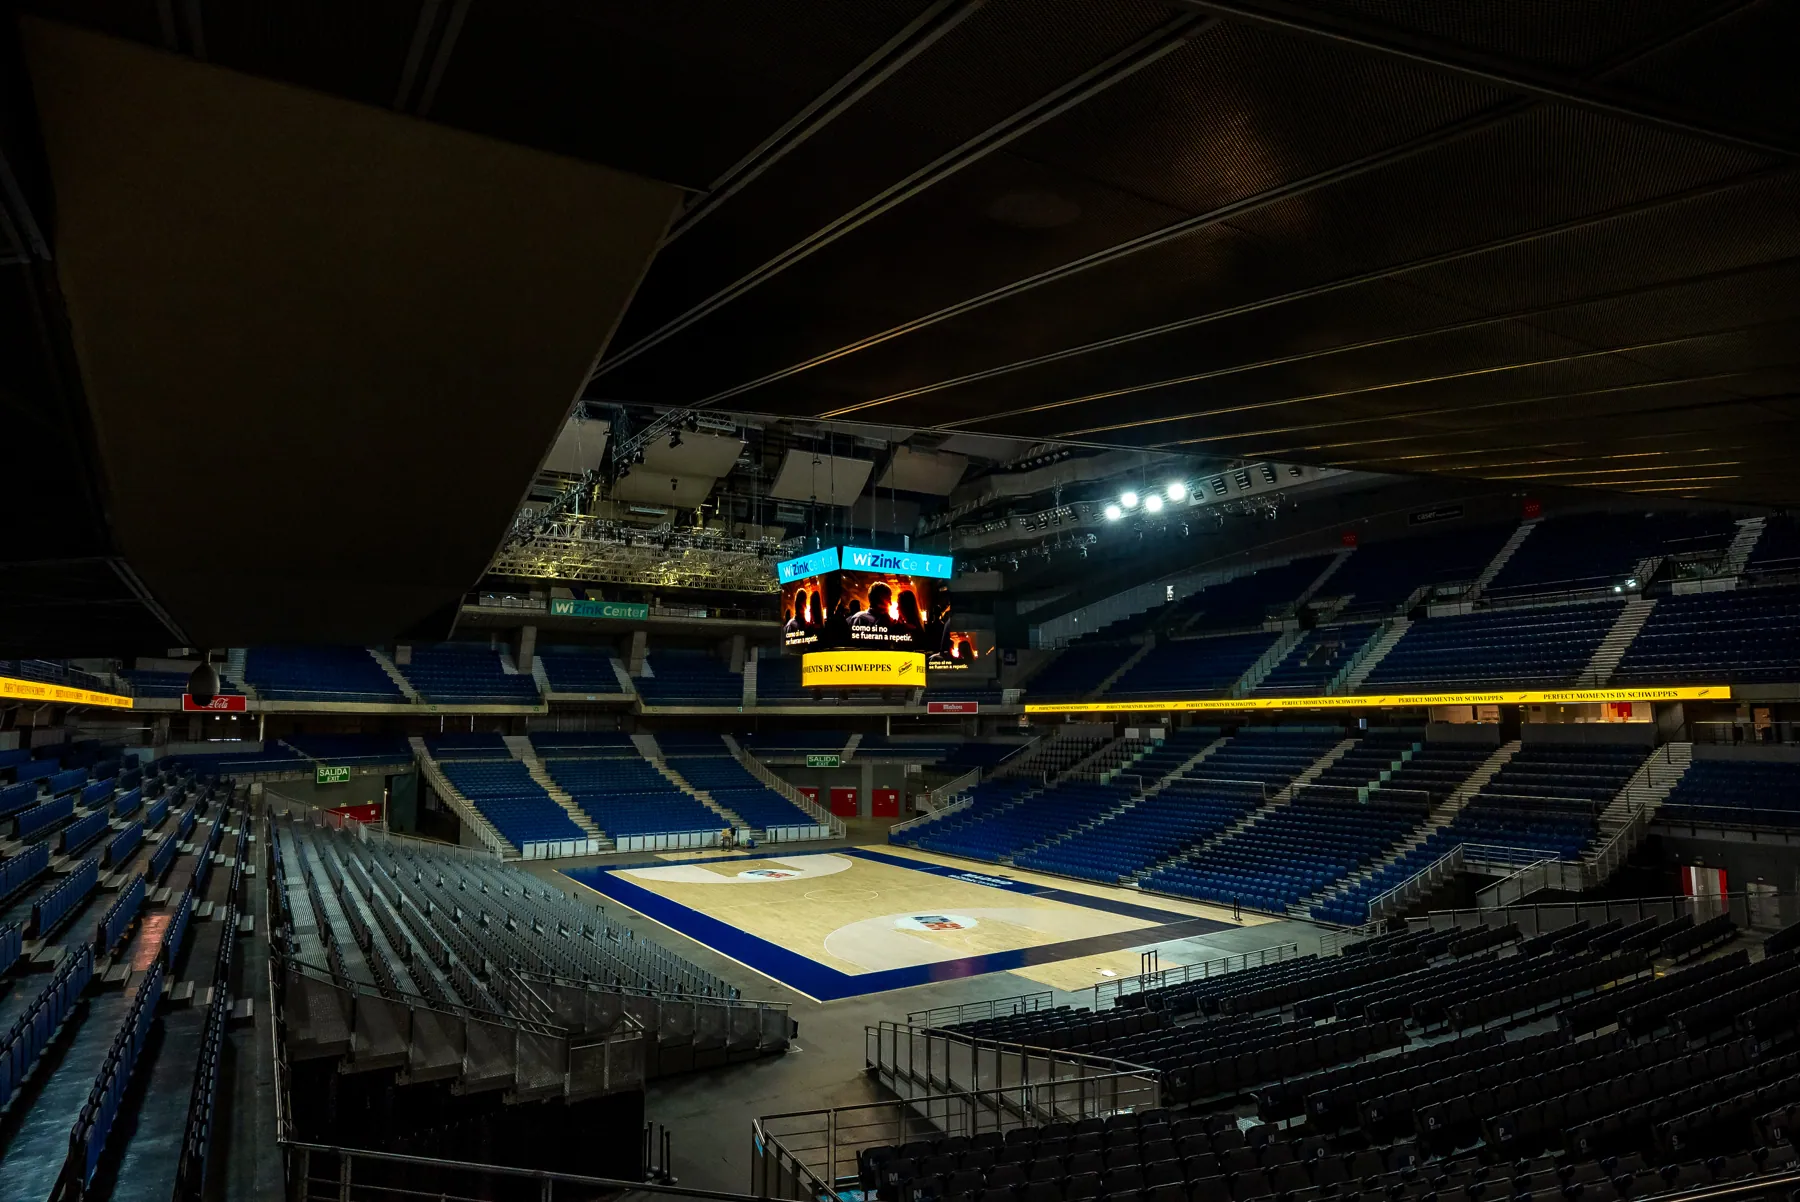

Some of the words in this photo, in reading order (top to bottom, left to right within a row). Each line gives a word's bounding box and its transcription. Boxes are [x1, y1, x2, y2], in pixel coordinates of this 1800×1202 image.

[871, 624, 878, 632] si
[860, 631, 883, 640] fueran
[889, 633, 913, 643] repetir.
[835, 664, 892, 672] SCHWEPPES
[1628, 690, 1678, 698] SCHWEPPES
[319, 768, 348, 777] SALIDA
